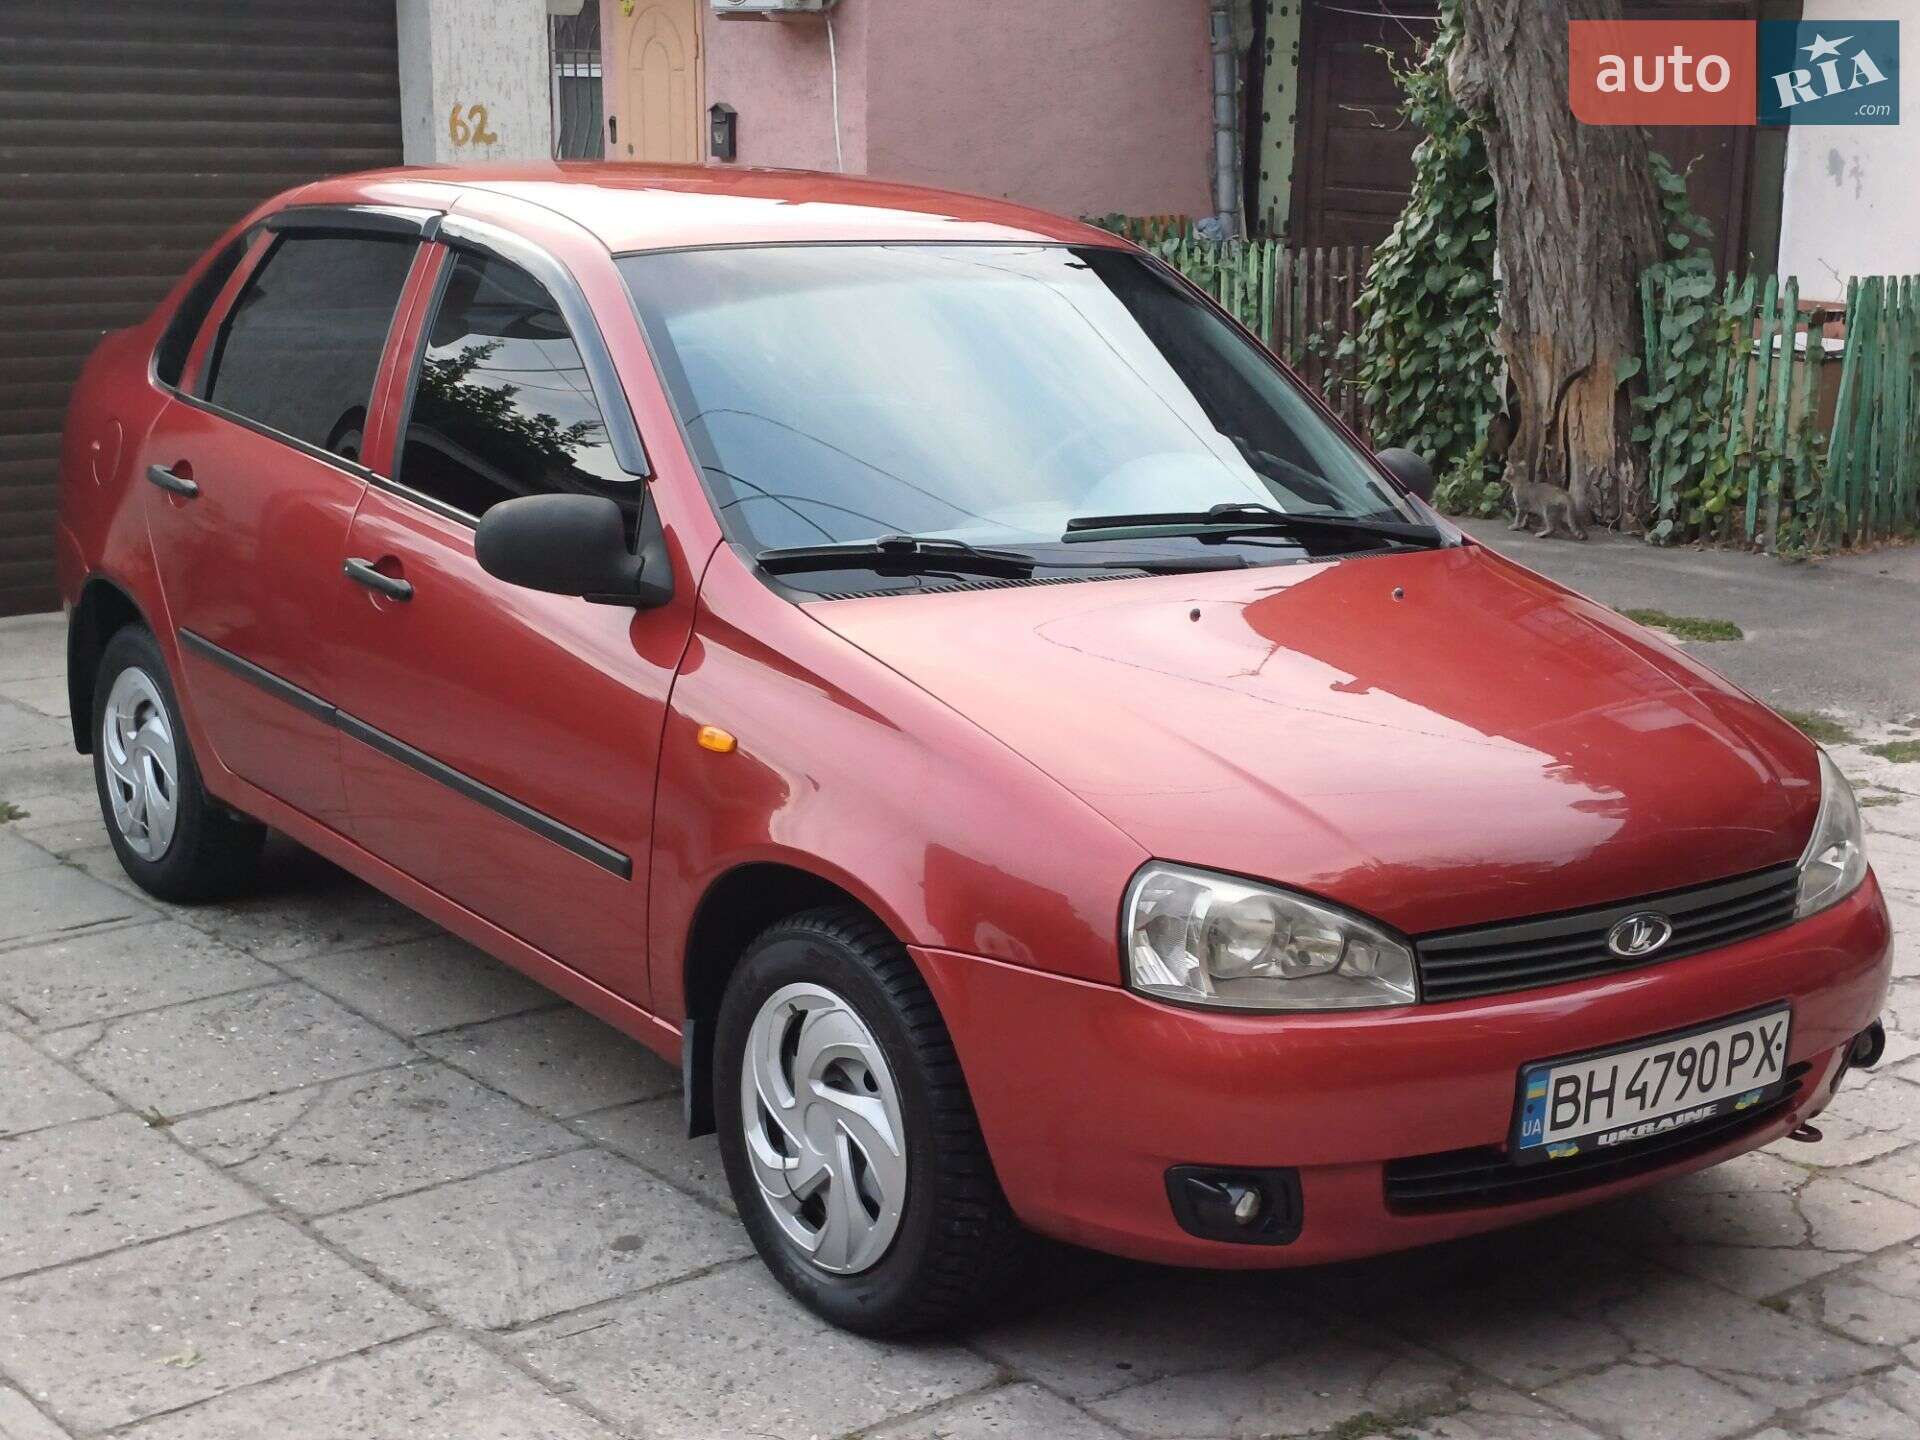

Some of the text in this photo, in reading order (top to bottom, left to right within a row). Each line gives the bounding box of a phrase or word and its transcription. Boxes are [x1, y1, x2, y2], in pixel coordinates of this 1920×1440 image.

[449, 102, 498, 146] 62
[1549, 1020, 1784, 1131] BH 4790 PX
[1521, 1119, 1542, 1137] UA
[1597, 1104, 1718, 1146] UKRAINE
